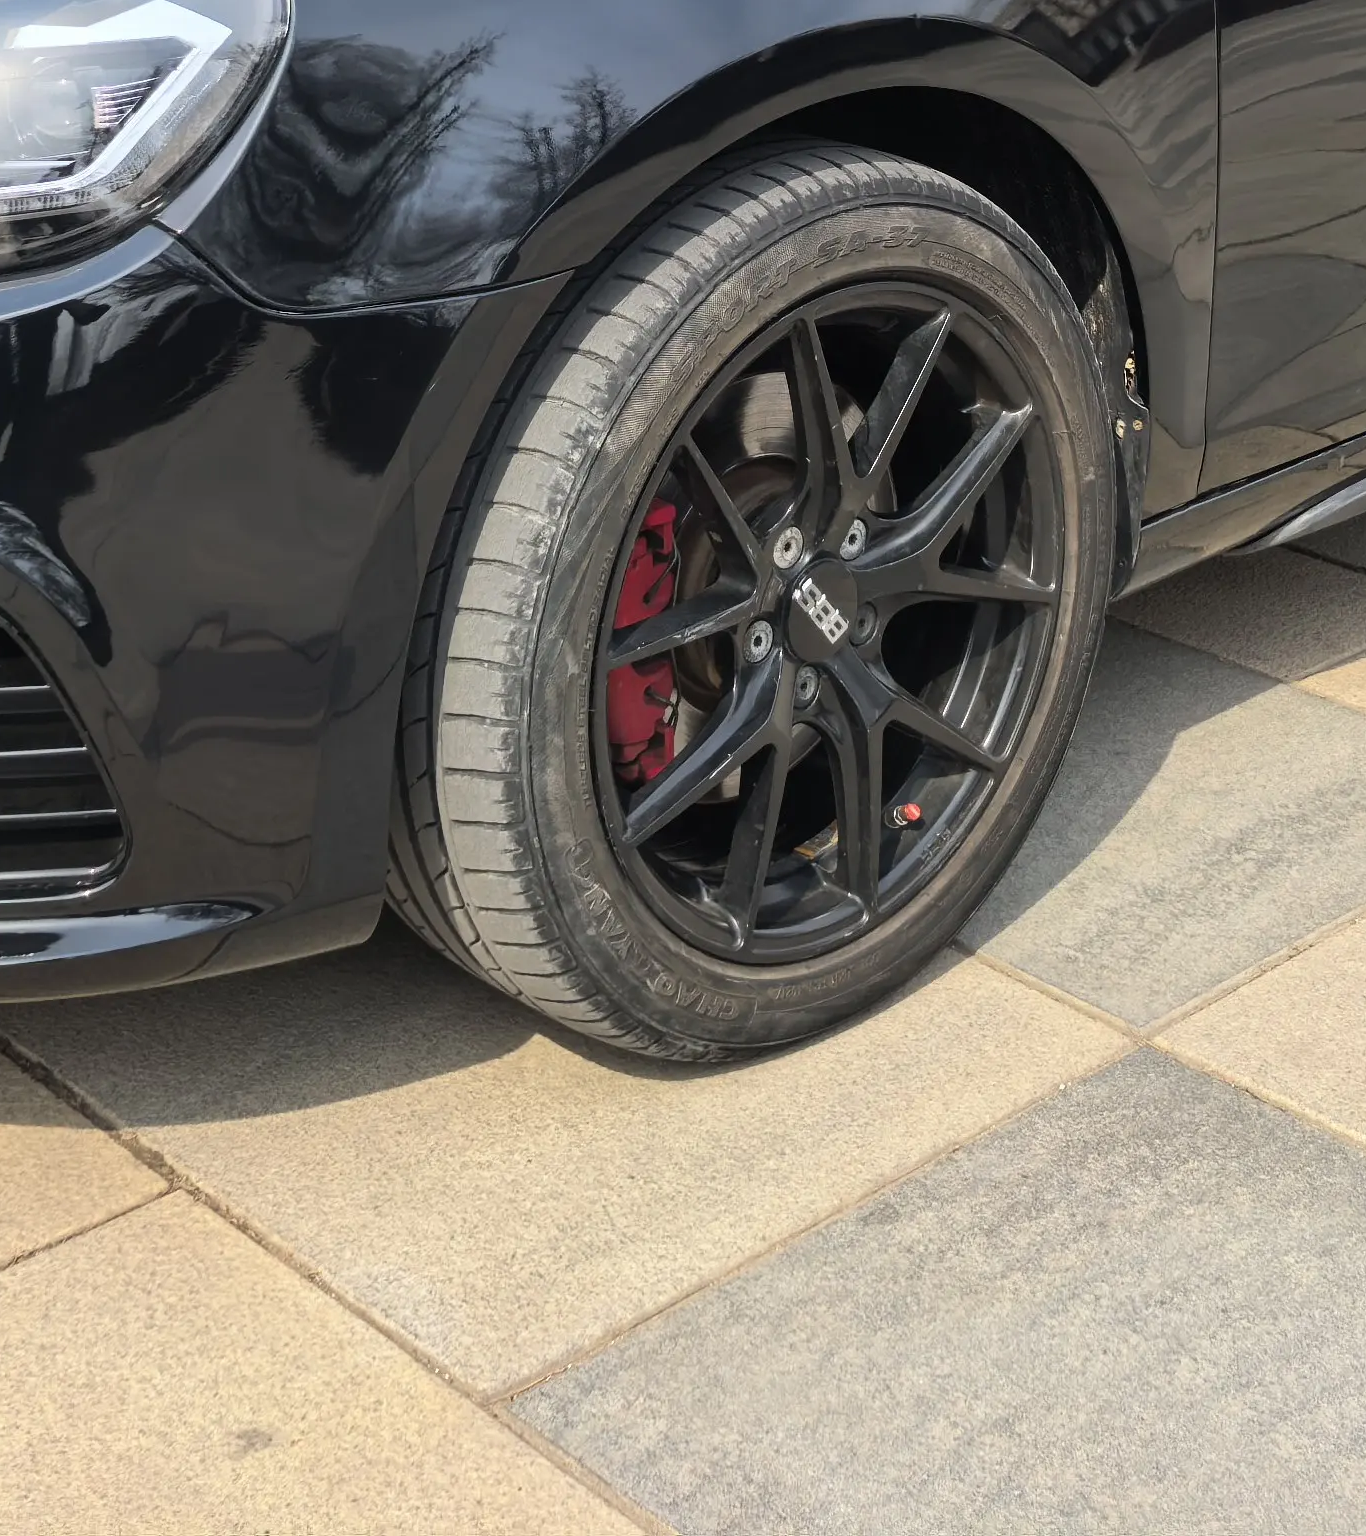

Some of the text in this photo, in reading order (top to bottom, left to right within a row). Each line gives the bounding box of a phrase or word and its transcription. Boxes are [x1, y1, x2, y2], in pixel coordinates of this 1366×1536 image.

[666, 224, 929, 390] SPORT SA-37
[792, 578, 849, 644] BBS
